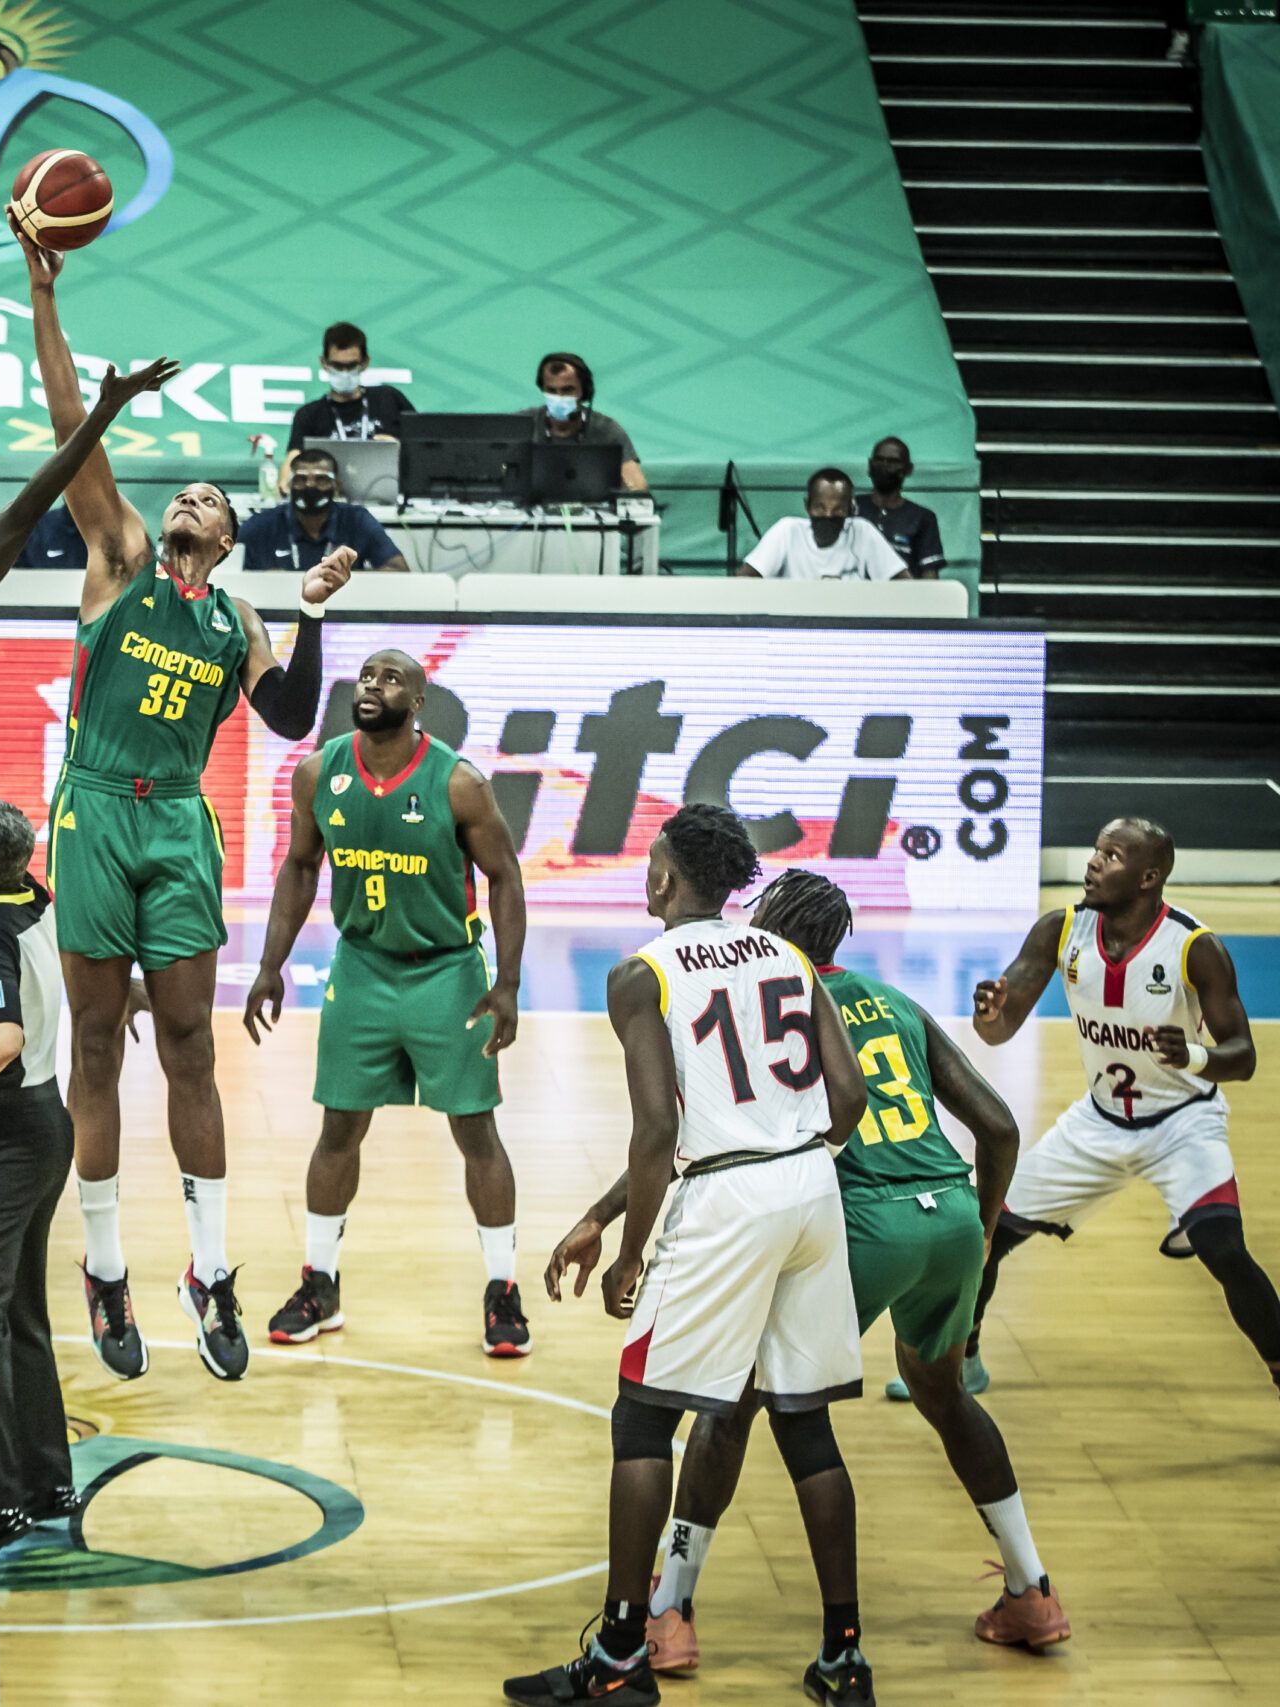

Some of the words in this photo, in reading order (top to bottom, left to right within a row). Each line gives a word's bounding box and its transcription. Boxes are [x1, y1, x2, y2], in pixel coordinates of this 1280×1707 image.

[5, 417, 202, 457] 221
[138, 673, 194, 721] 35
[957, 714, 1011, 862] COM
[364, 873, 387, 912] 9
[675, 935, 780, 973] KALUMA
[841, 996, 896, 1029] ACE
[690, 974, 823, 1106] 15
[1076, 1013, 1154, 1053] UGANDA
[1105, 1061, 1143, 1101] 2
[669, 1522, 693, 1562] PEAK
